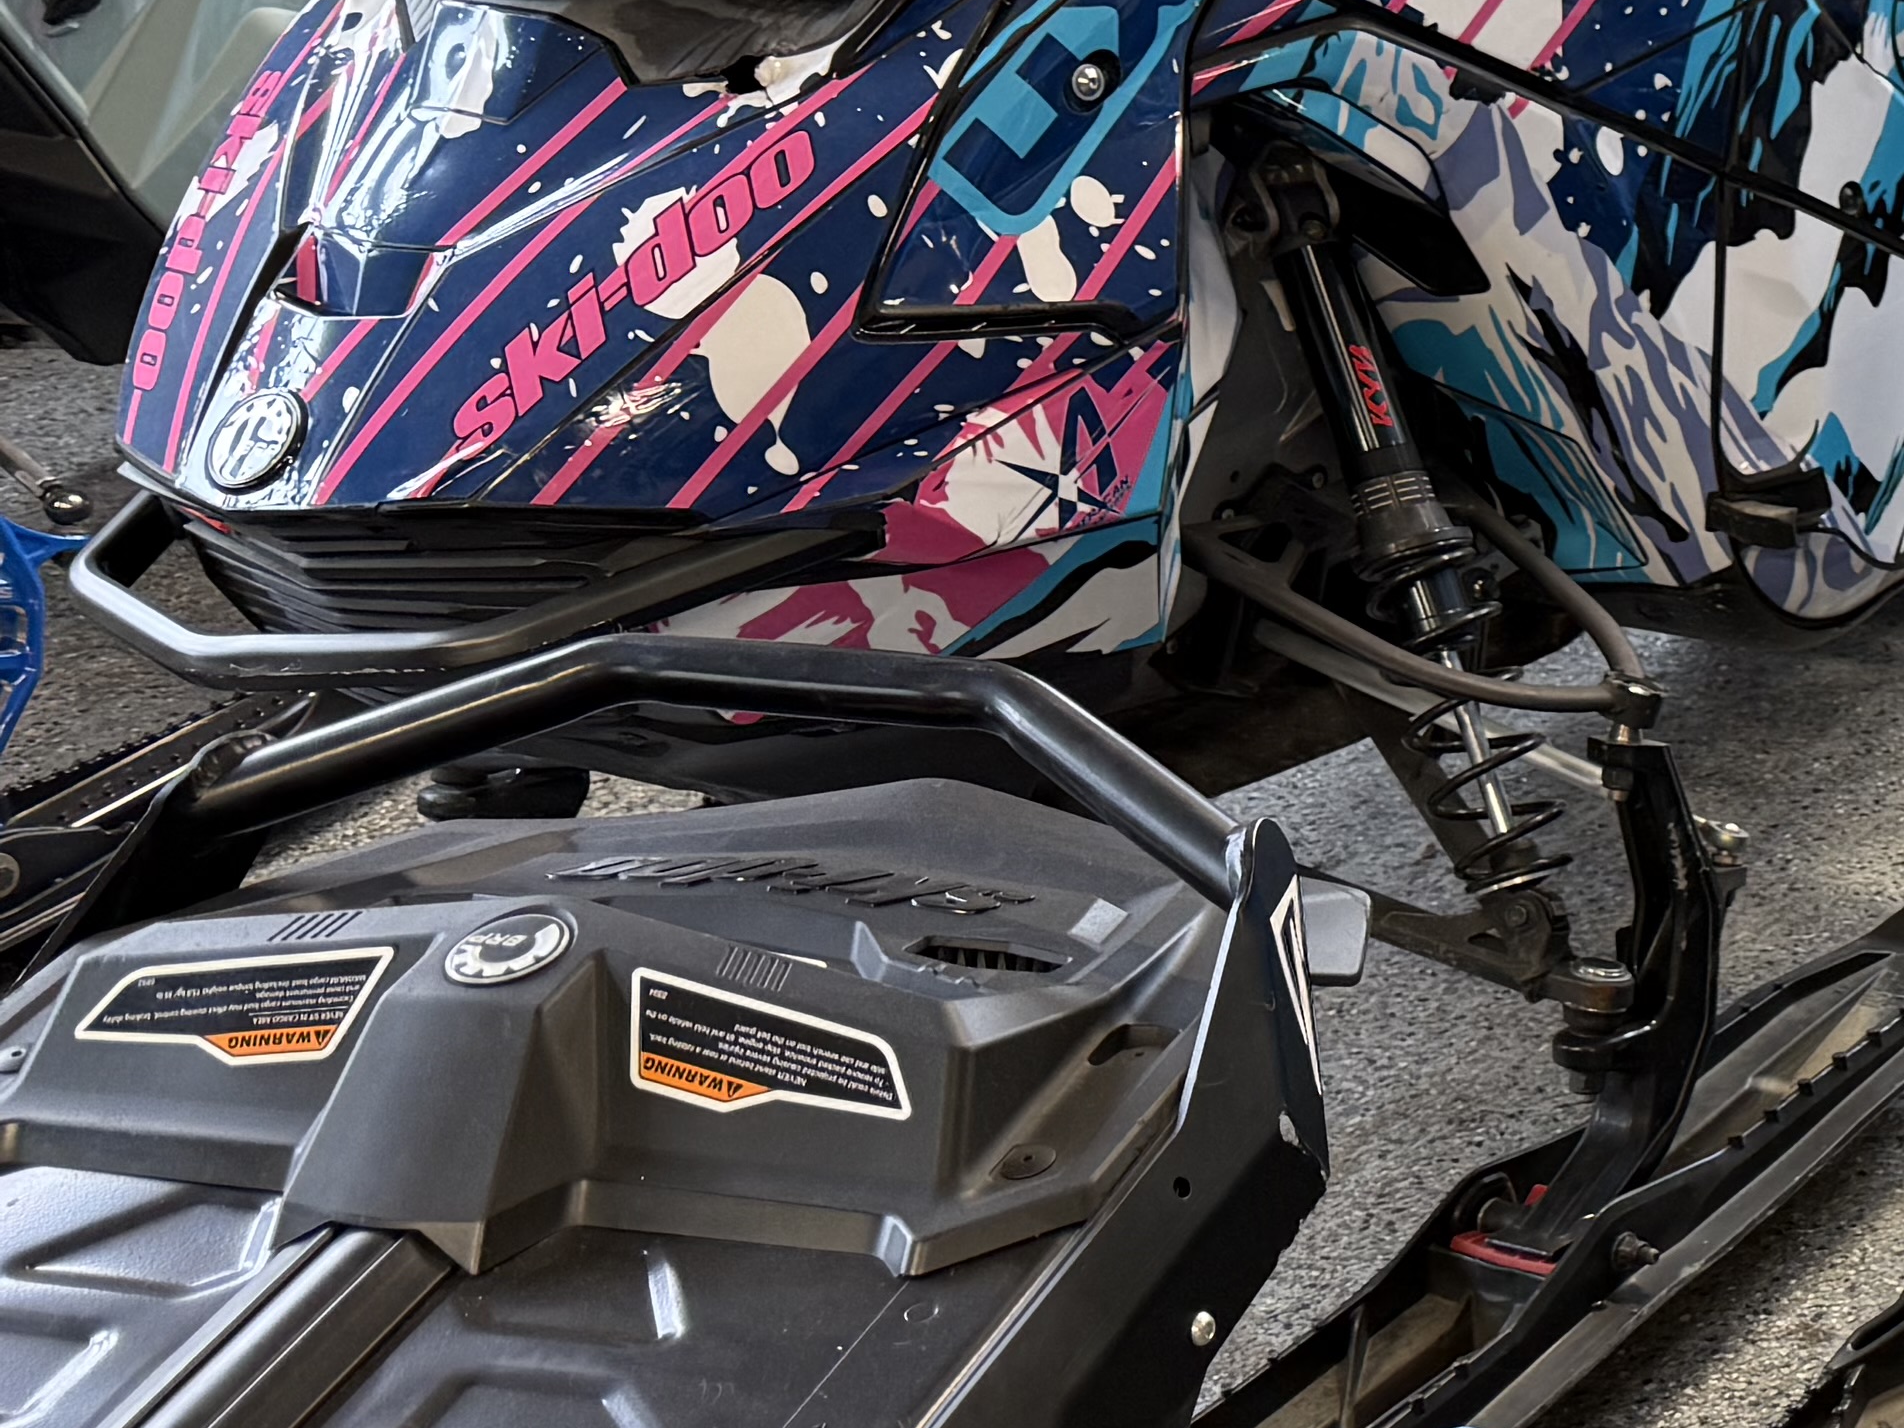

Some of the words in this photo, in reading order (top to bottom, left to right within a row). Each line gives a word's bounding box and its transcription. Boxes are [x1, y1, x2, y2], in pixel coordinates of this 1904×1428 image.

[453, 129, 815, 448] ski-doo
[466, 932, 529, 947] BRP
[228, 1032, 310, 1048] WARNING
[643, 1057, 724, 1092] WARNING
